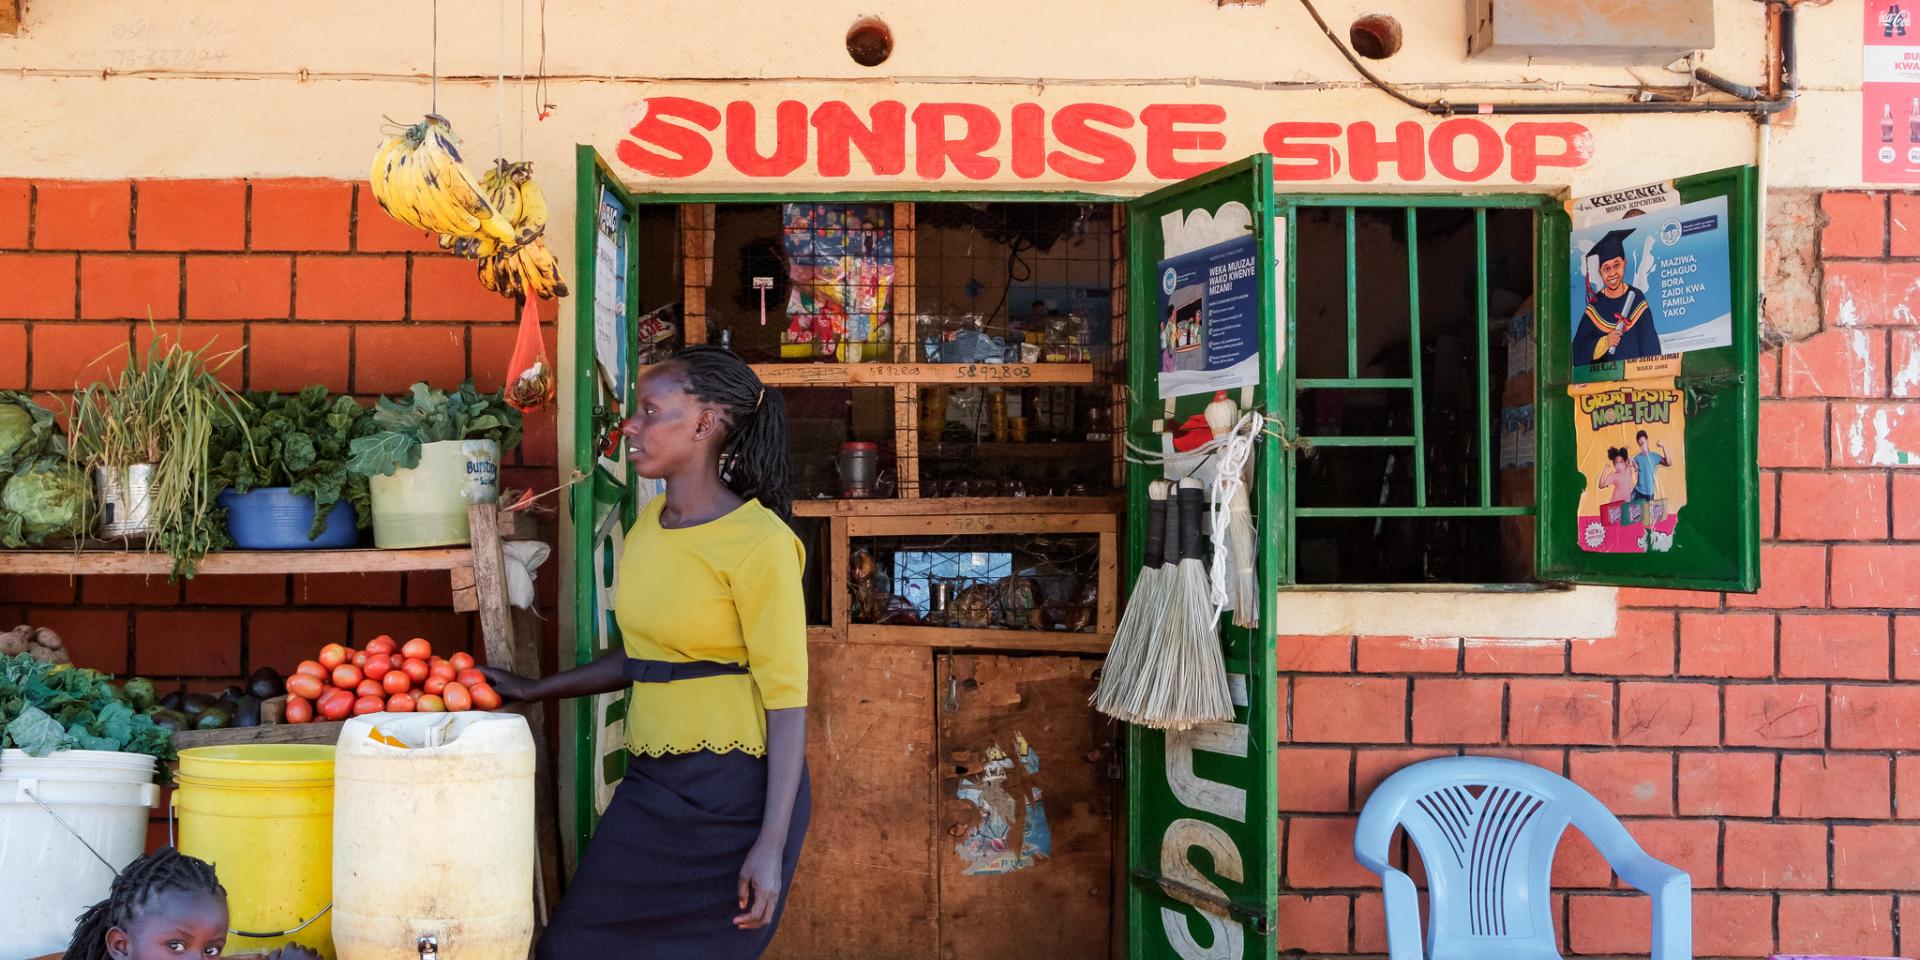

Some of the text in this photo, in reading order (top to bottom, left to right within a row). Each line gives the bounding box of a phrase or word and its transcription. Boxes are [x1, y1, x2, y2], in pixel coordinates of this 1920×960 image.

[617, 97, 1594, 180] SUNRISE SHOP
[1590, 183, 1668, 208] KERENEI
[1208, 264, 1227, 277] WEKA
[1227, 256, 1256, 272] MUUZAJI
[1660, 254, 1698, 268] MAZIWA,
[1208, 272, 1228, 286] WAKO
[1228, 266, 1256, 281] KWENYE
[1661, 264, 1697, 278] CHAGUO
[1661, 277, 1685, 288] BORA
[1661, 283, 1706, 298] ZAIDI KWA
[1662, 295, 1696, 308] FAMILIA
[1662, 306, 1686, 318] YAKO
[955, 365, 1032, 380] 5892803
[1580, 387, 1634, 414] GREAT
[1592, 401, 1671, 431] MORE FUN
